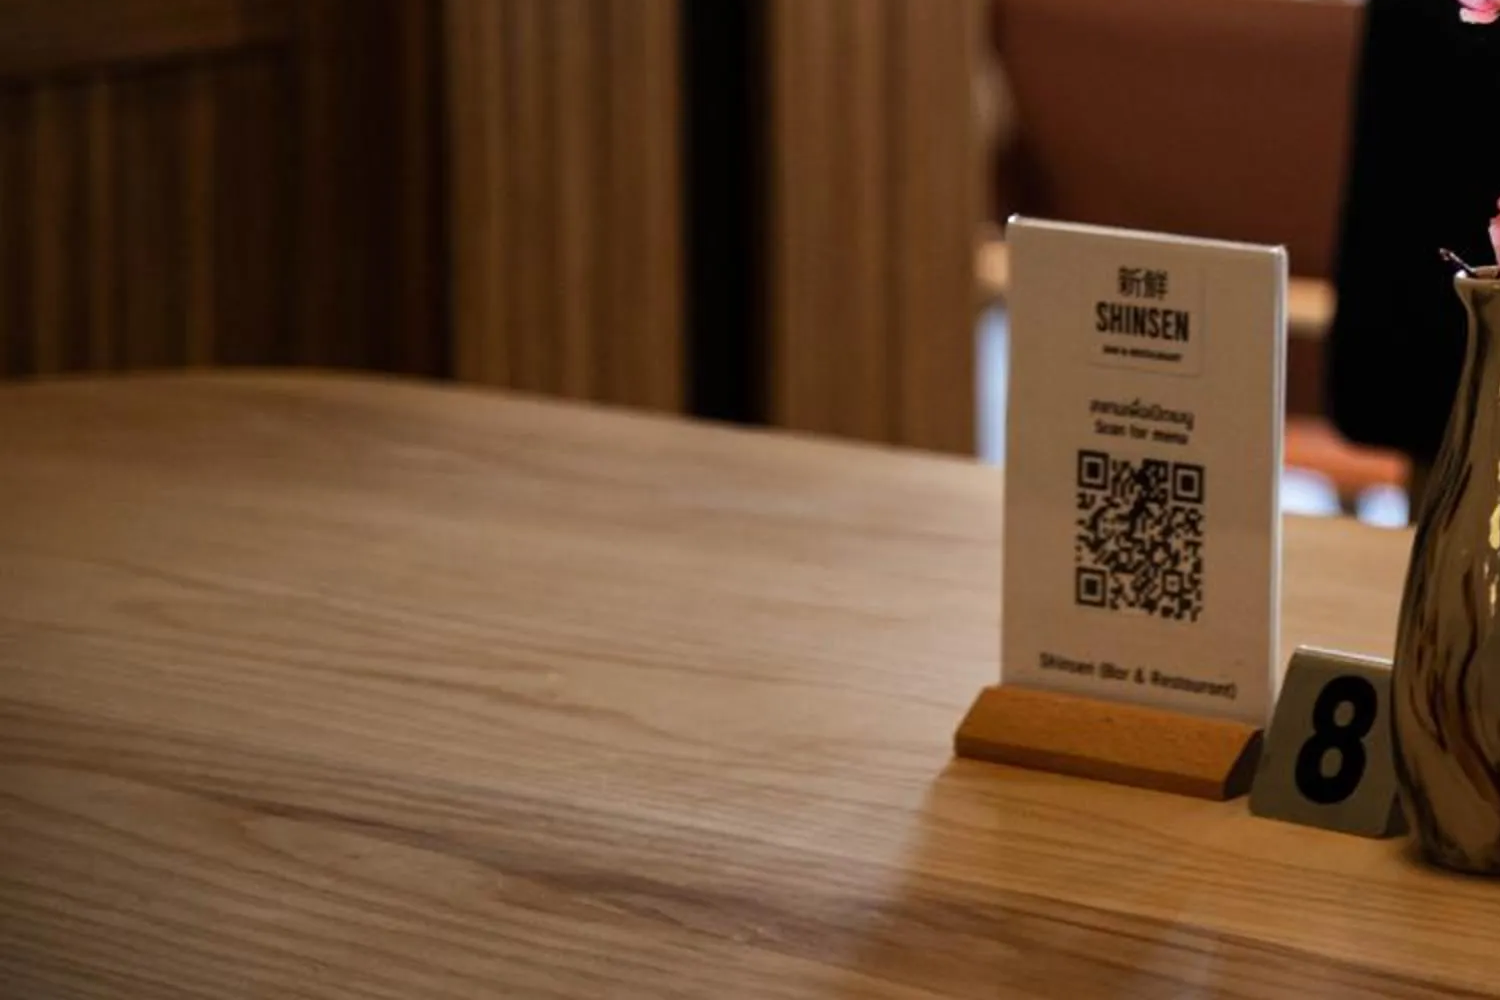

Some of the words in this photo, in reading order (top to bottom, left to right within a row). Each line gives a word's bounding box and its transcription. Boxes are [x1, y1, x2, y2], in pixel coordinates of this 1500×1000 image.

[1118, 266, 1168, 300] 新鮮
[1095, 301, 1189, 342] SHINSEN
[1129, 424, 1148, 440] for
[1039, 652, 1095, 675] Shinsen
[1134, 667, 1145, 684] &
[1296, 675, 1378, 804] 8
